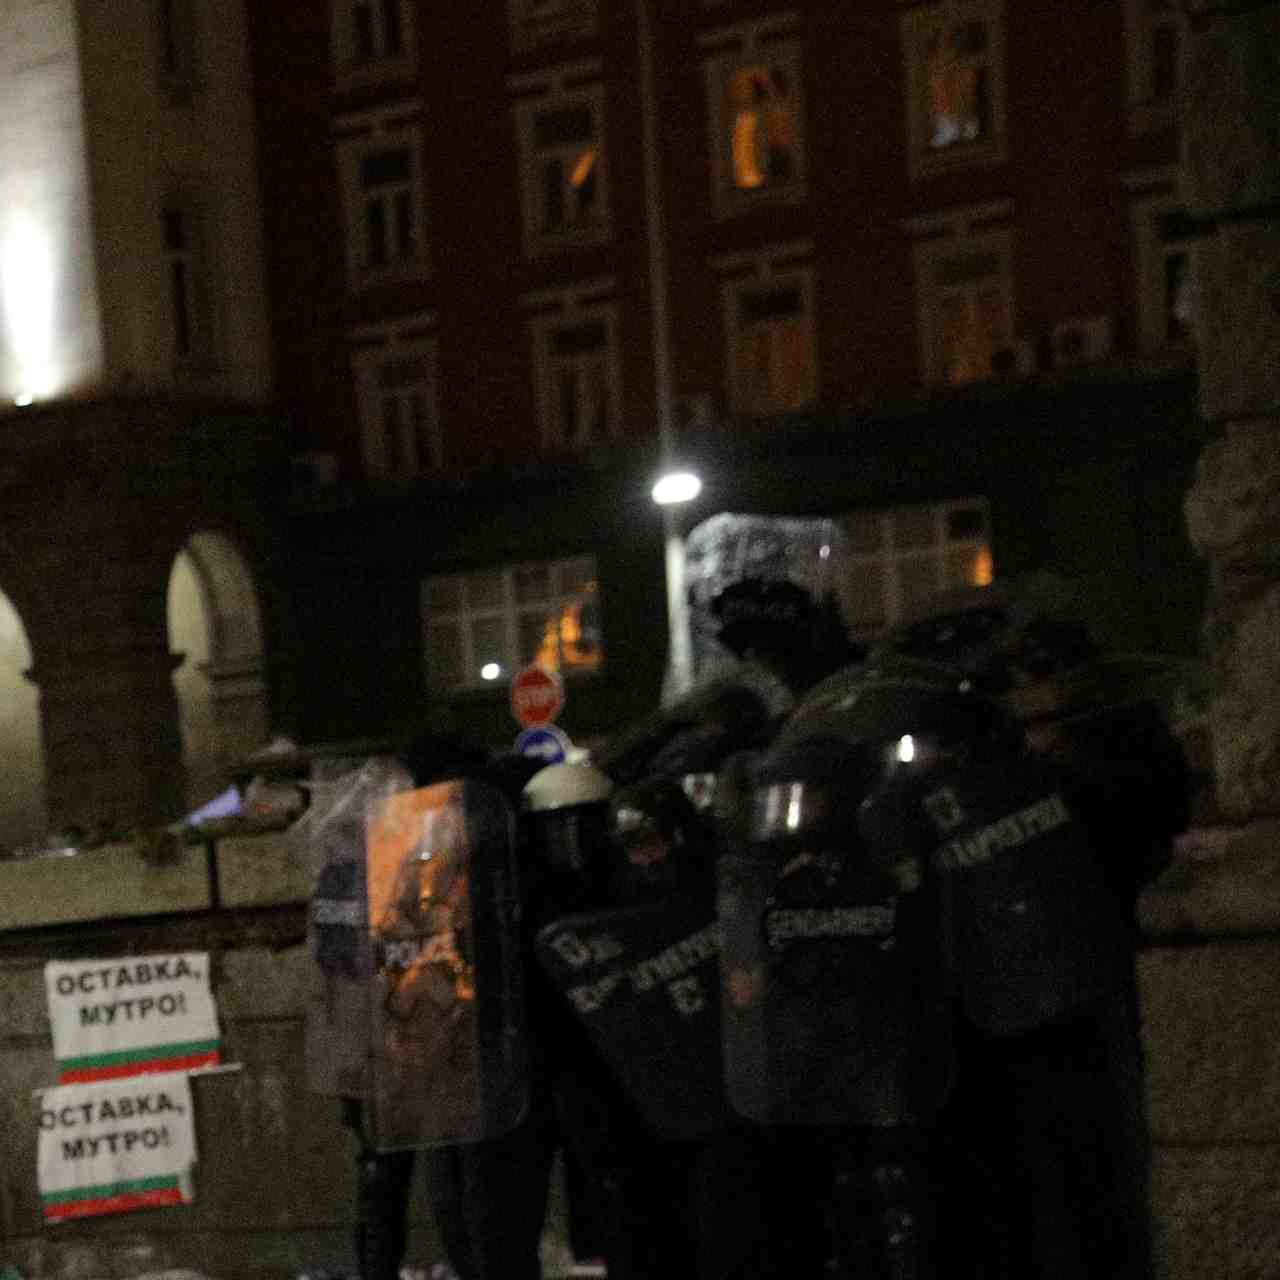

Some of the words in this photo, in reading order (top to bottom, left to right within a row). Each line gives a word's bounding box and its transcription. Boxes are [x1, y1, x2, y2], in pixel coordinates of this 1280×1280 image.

[56, 957, 201, 996] ОСТАВКА,
[80, 995, 187, 1027] МУТРО!
[40, 1092, 184, 1131] ОСТАВКА,
[63, 1126, 168, 1160] МУТРО!
